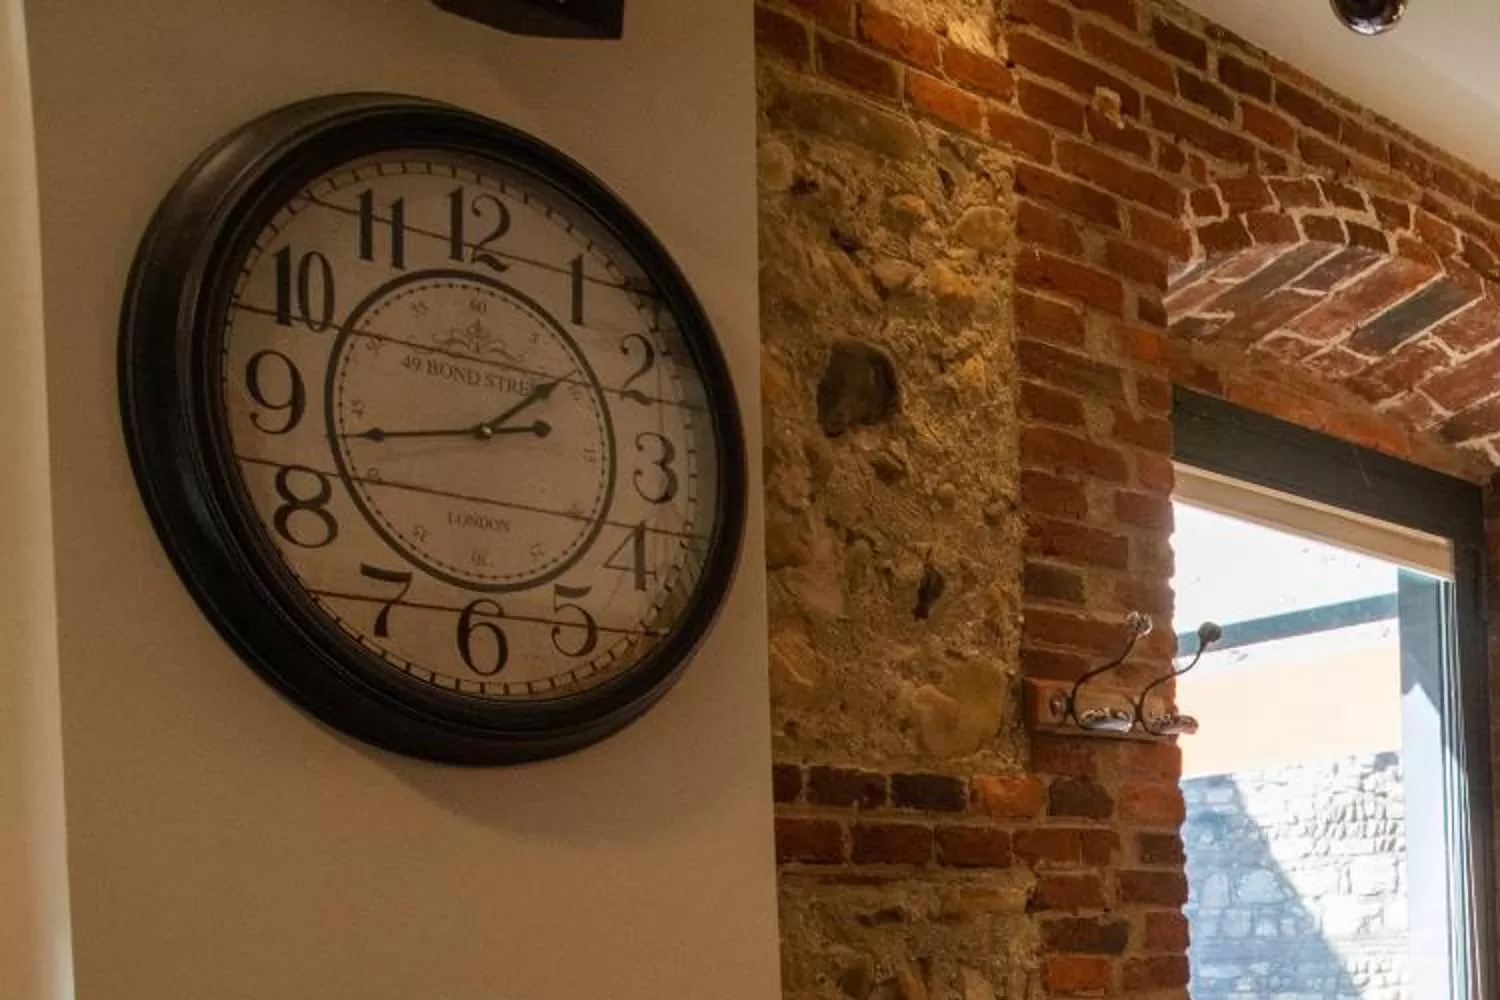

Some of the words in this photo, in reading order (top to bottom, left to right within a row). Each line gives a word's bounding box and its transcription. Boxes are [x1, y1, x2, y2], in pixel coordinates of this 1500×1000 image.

[357, 188, 406, 270] 11
[446, 186, 511, 272] 12
[272, 244, 335, 332] 10
[569, 253, 585, 326] 1
[245, 349, 307, 434] 9
[425, 358, 482, 386] BOND
[619, 333, 657, 406] 2
[273, 463, 338, 549] 8
[632, 433, 679, 506] 3
[446, 510, 511, 533] LONDON
[602, 521, 657, 594] 4
[359, 562, 414, 638] 7
[456, 597, 511, 677] 6
[551, 584, 600, 658] 5
